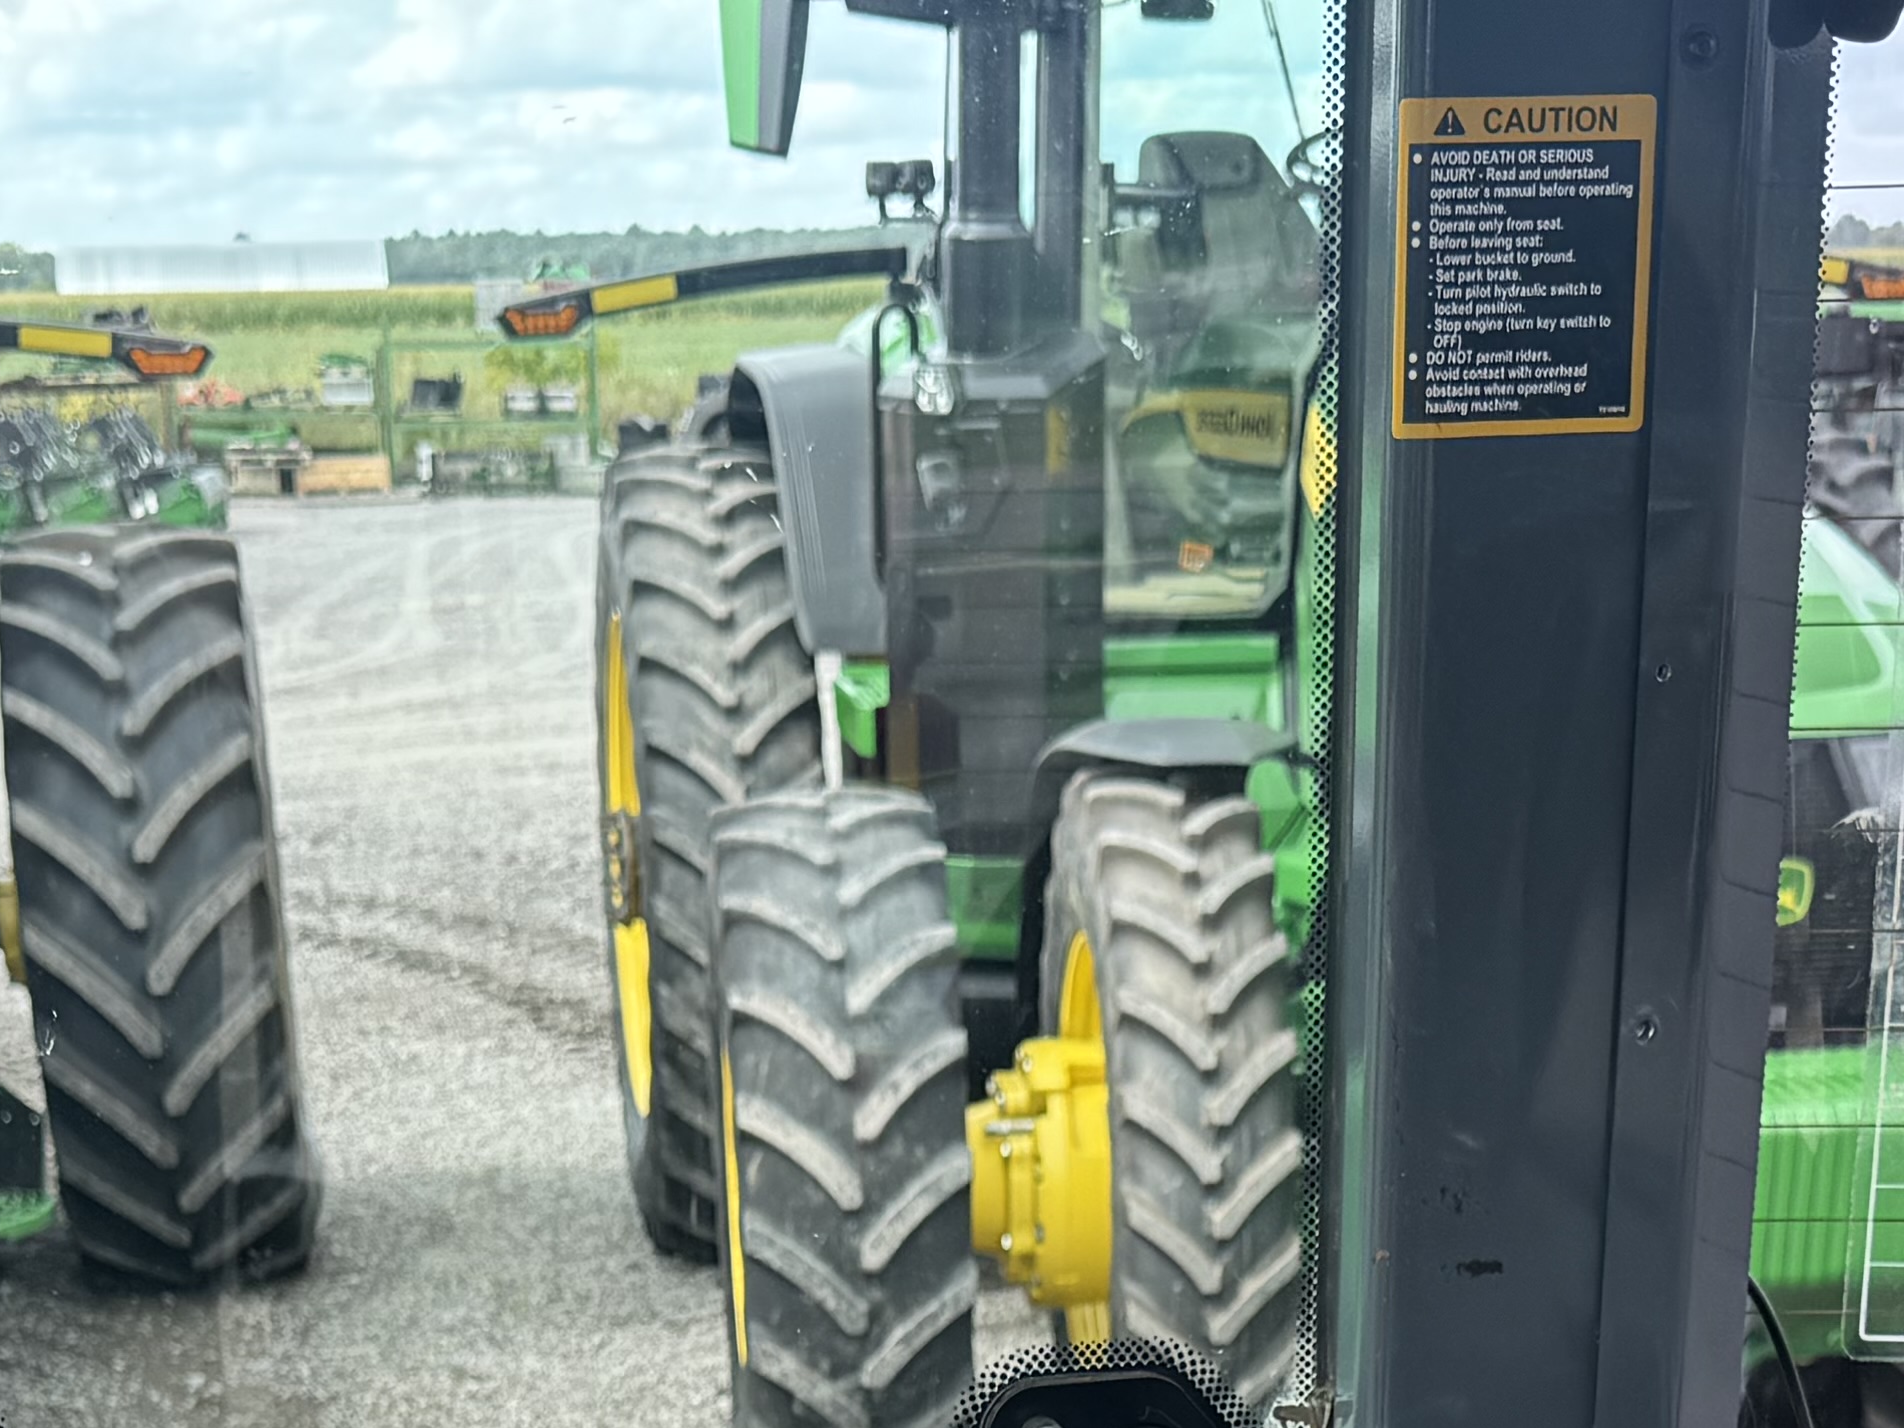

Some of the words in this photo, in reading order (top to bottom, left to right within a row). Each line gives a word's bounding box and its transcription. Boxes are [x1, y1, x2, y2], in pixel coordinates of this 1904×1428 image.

[1484, 105, 1617, 133] CAUTION
[1431, 151, 1470, 165] AVOID
[1474, 150, 1515, 164] DEATH
[1518, 149, 1536, 163] OR
[1540, 148, 1593, 163] SERIOUS
[1430, 168, 1475, 182] INJURY
[1486, 167, 1516, 181] Read
[1519, 166, 1540, 180] and
[1544, 165, 1609, 180] understand
[1430, 185, 1490, 201] operator's
[1494, 184, 1536, 198] manual
[1539, 183, 1575, 197] before
[1579, 182, 1633, 199] operating
[1430, 202, 1451, 216] this
[1455, 200, 1507, 215] machine.
[1429, 219, 1475, 234] Operate
[1479, 218, 1503, 234] only
[1506, 217, 1534, 231] from
[1537, 217, 1564, 231] seat.
[1429, 236, 1467, 249] Before
[1470, 235, 1512, 251] leaving
[1515, 234, 1543, 248] seat:
[1436, 252, 1472, 266] Lower
[1475, 251, 1514, 265] bucket
[1517, 251, 1528, 264] to
[1531, 249, 1576, 267] ground.
[1435, 269, 1455, 283] Set
[1458, 268, 1483, 285] park
[1487, 268, 1522, 282] brake.
[1435, 286, 1462, 300] Turn
[1465, 285, 1491, 301] pilot
[1494, 284, 1546, 300] hydraulic
[1550, 283, 1587, 296] switch
[1590, 283, 1602, 295] to
[1434, 302, 1472, 316] locked
[1475, 301, 1525, 318] position.
[1434, 319, 1461, 335] Stop
[1464, 318, 1503, 333] engine
[1506, 317, 1534, 332] (turn
[1537, 316, 1556, 332] key
[1559, 315, 1596, 329] switch
[1599, 315, 1611, 327] to
[1433, 335, 1462, 349] OFF)
[1426, 352, 1445, 365] DO
[1448, 351, 1472, 365] NOT
[1476, 350, 1513, 366] permit
[1515, 349, 1551, 363] riders.
[1426, 367, 1460, 381] Avoid
[1463, 366, 1505, 380] contact
[1508, 365, 1532, 379] with
[1535, 364, 1588, 378] overhead
[1426, 384, 1480, 398] obstacles
[1484, 383, 1514, 396] when
[1517, 381, 1571, 397] operating
[1574, 382, 1586, 393] or
[1425, 401, 1468, 416] hauling
[1471, 400, 1520, 413] machine.
